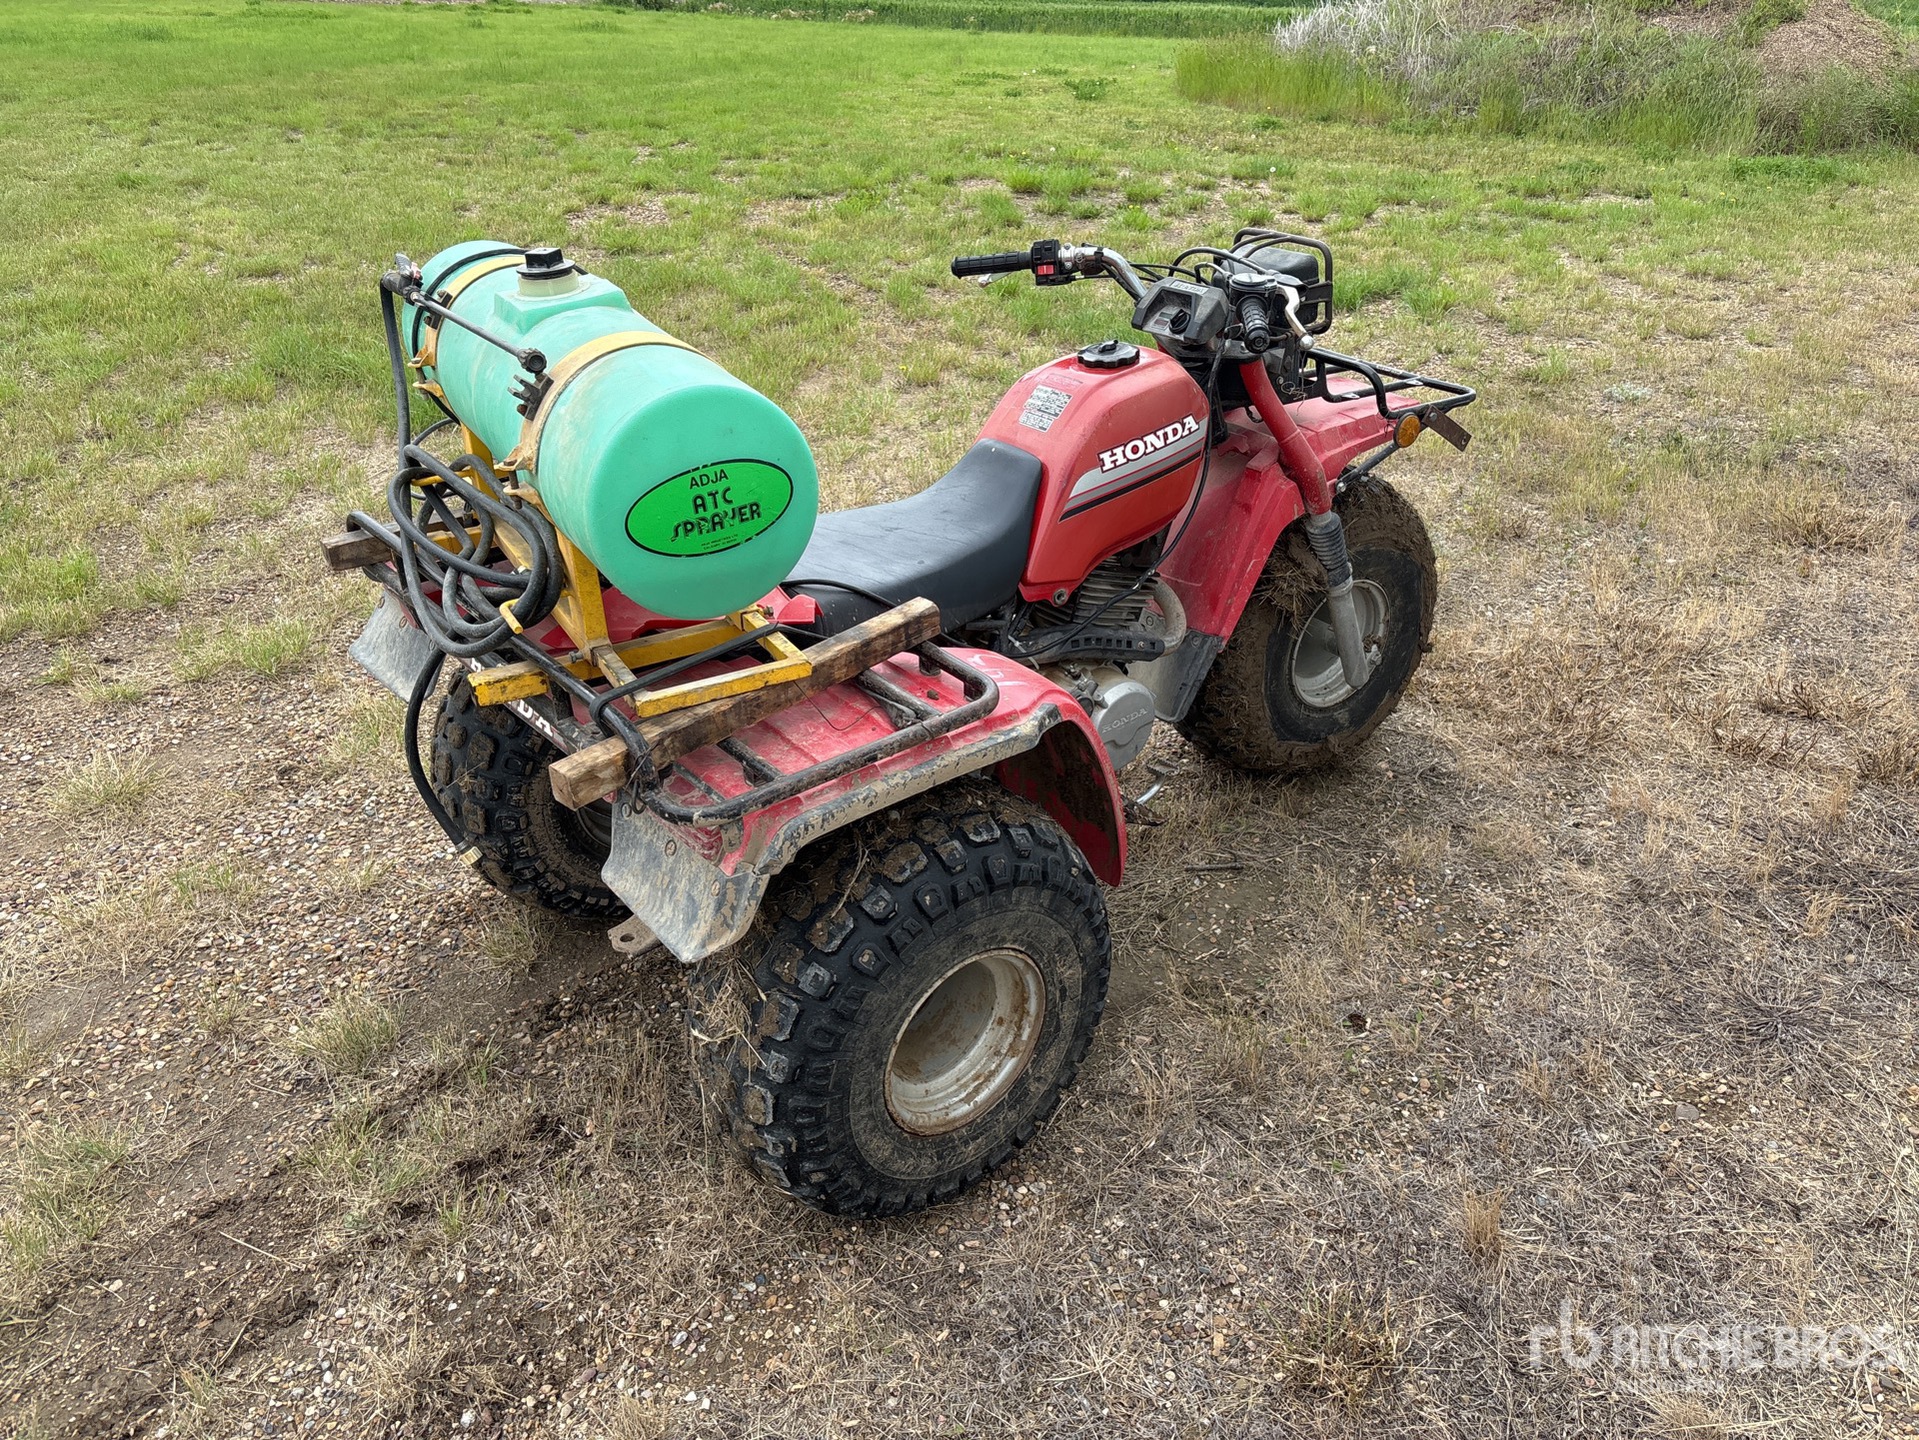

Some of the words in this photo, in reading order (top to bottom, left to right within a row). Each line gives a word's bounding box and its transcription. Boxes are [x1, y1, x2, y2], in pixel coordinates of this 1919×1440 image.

[1098, 413, 1199, 472] HONDA
[689, 469, 729, 490] ADJA
[692, 486, 734, 514] ATC
[670, 501, 762, 542] SPRAYER
[1102, 708, 1147, 733] HONDA
